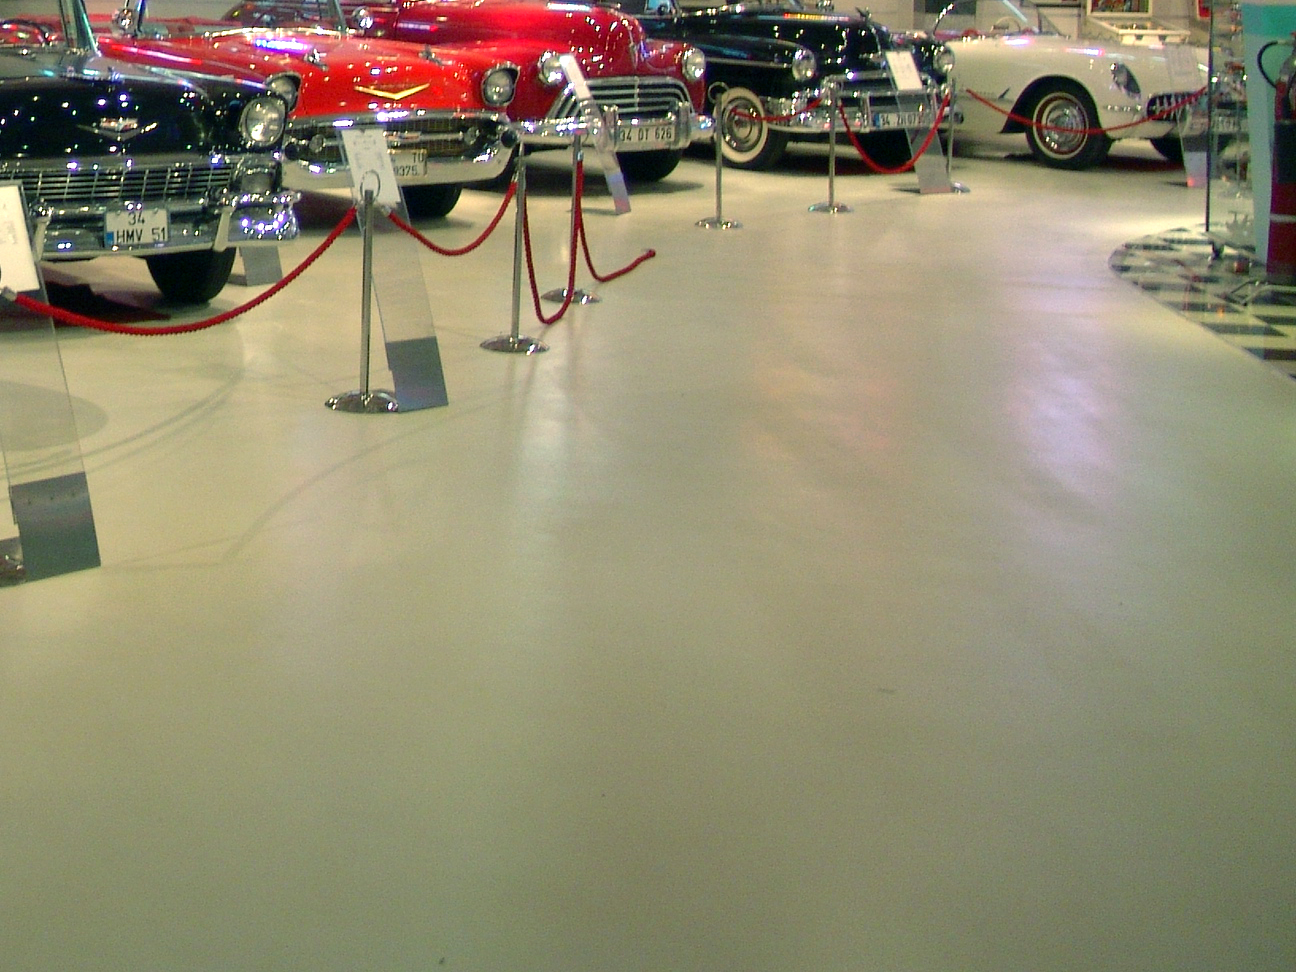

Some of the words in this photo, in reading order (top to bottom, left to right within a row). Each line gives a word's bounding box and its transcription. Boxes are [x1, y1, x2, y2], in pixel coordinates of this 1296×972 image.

[127, 210, 146, 226] 34
[115, 227, 144, 244] HMV
[150, 226, 167, 242] 51
